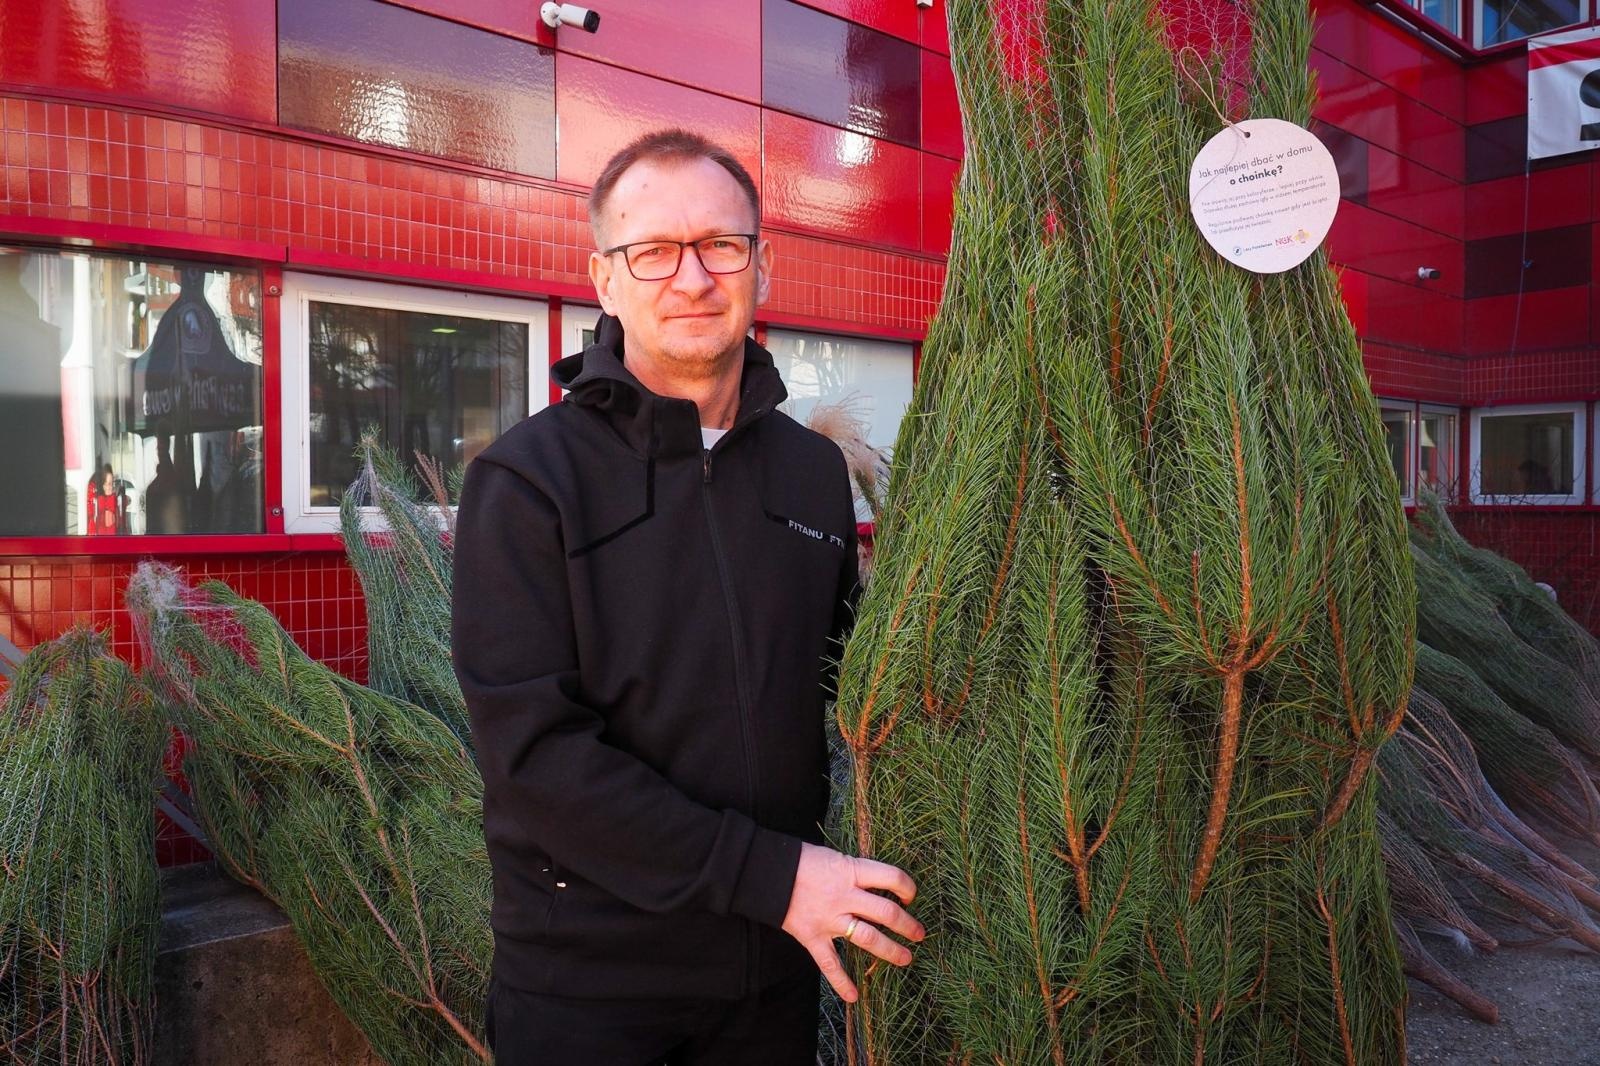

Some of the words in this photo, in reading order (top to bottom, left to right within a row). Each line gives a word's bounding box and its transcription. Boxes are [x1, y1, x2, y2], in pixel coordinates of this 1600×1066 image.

[1199, 168, 1212, 178] Jak
[1214, 161, 1249, 175] najlepiej
[1250, 154, 1273, 166] dbać
[1286, 145, 1313, 157] domu
[1238, 165, 1283, 182] choinkę?
[788, 519, 823, 540] FITANU
